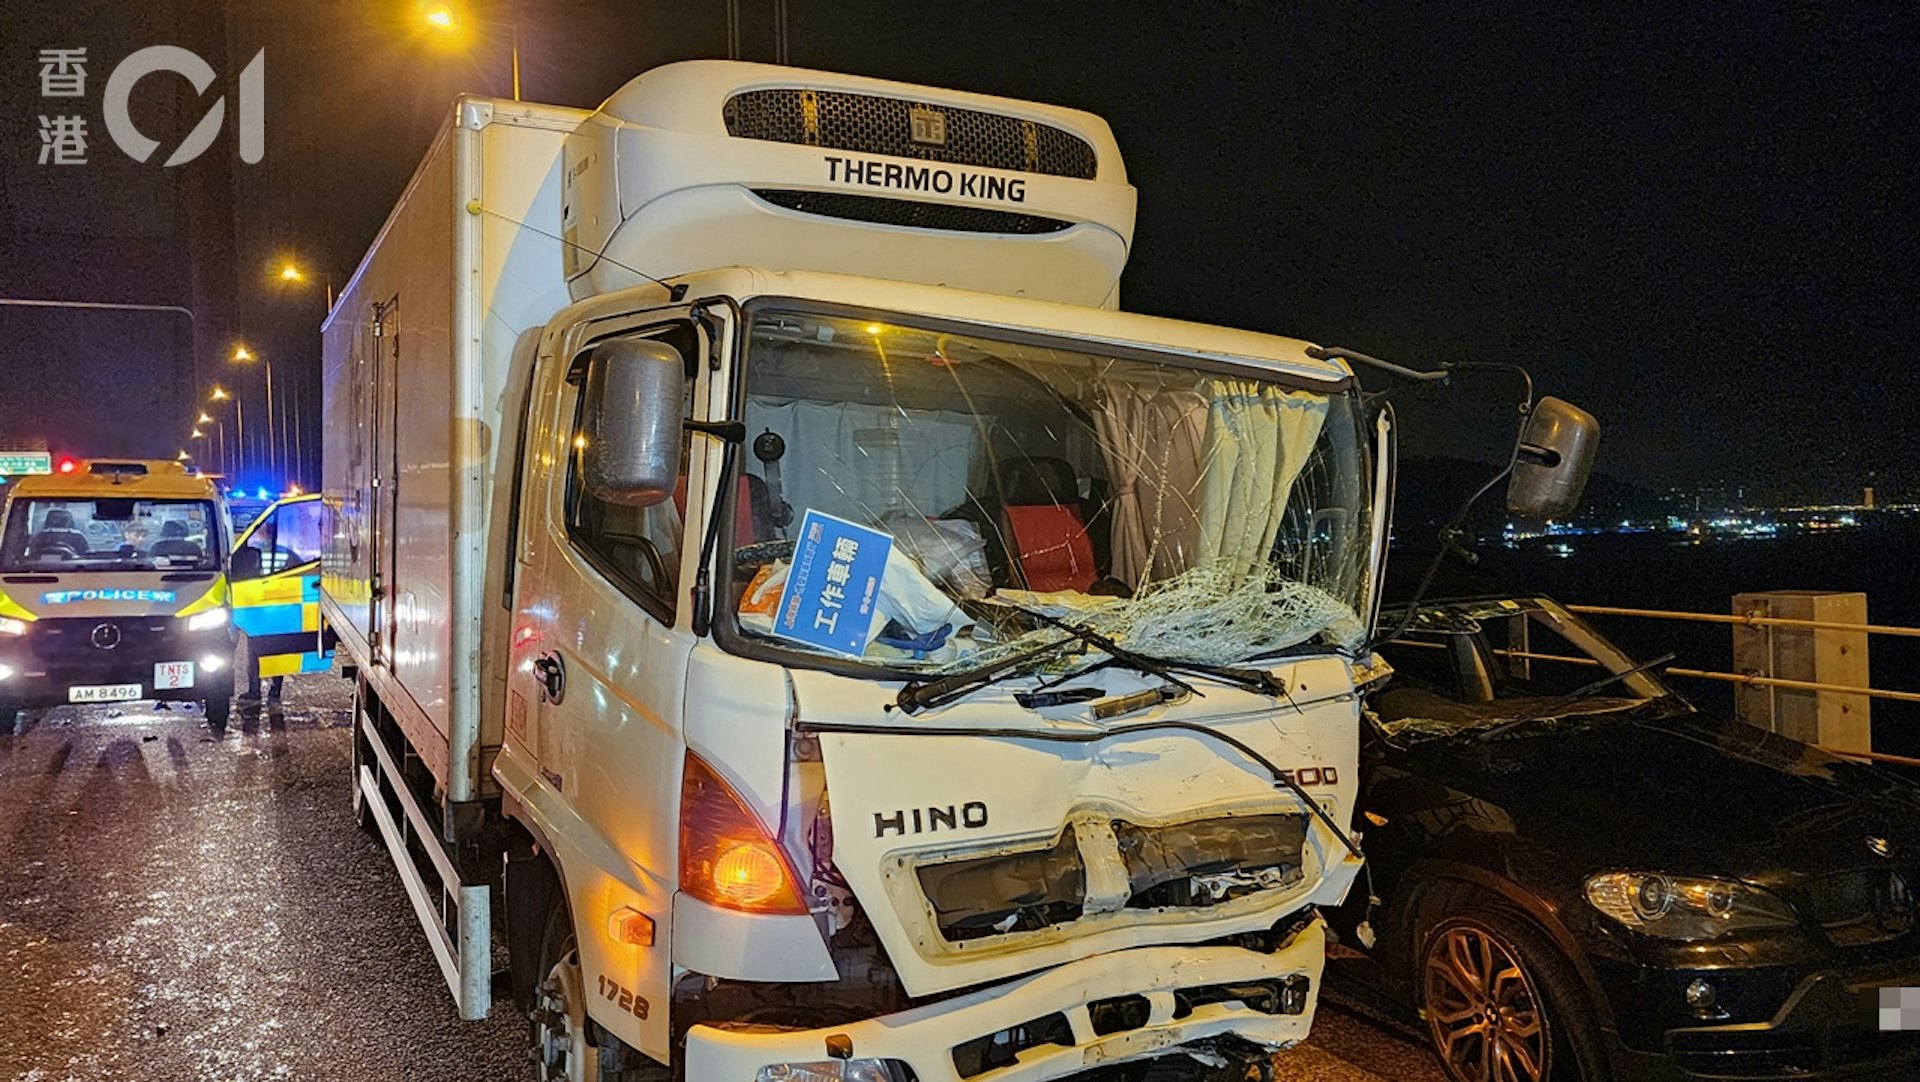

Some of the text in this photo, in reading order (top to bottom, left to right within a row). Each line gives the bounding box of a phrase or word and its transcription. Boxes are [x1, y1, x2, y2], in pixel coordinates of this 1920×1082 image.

[825, 156, 1025, 203] THERMO KING
[66, 589, 150, 602] POLICE
[813, 536, 860, 635] 工作車輛
[160, 664, 190, 676] TNTS
[169, 675, 180, 687] 2
[75, 686, 137, 699] AM 8496
[874, 801, 988, 838] HINO
[598, 974, 650, 1021] 1728
